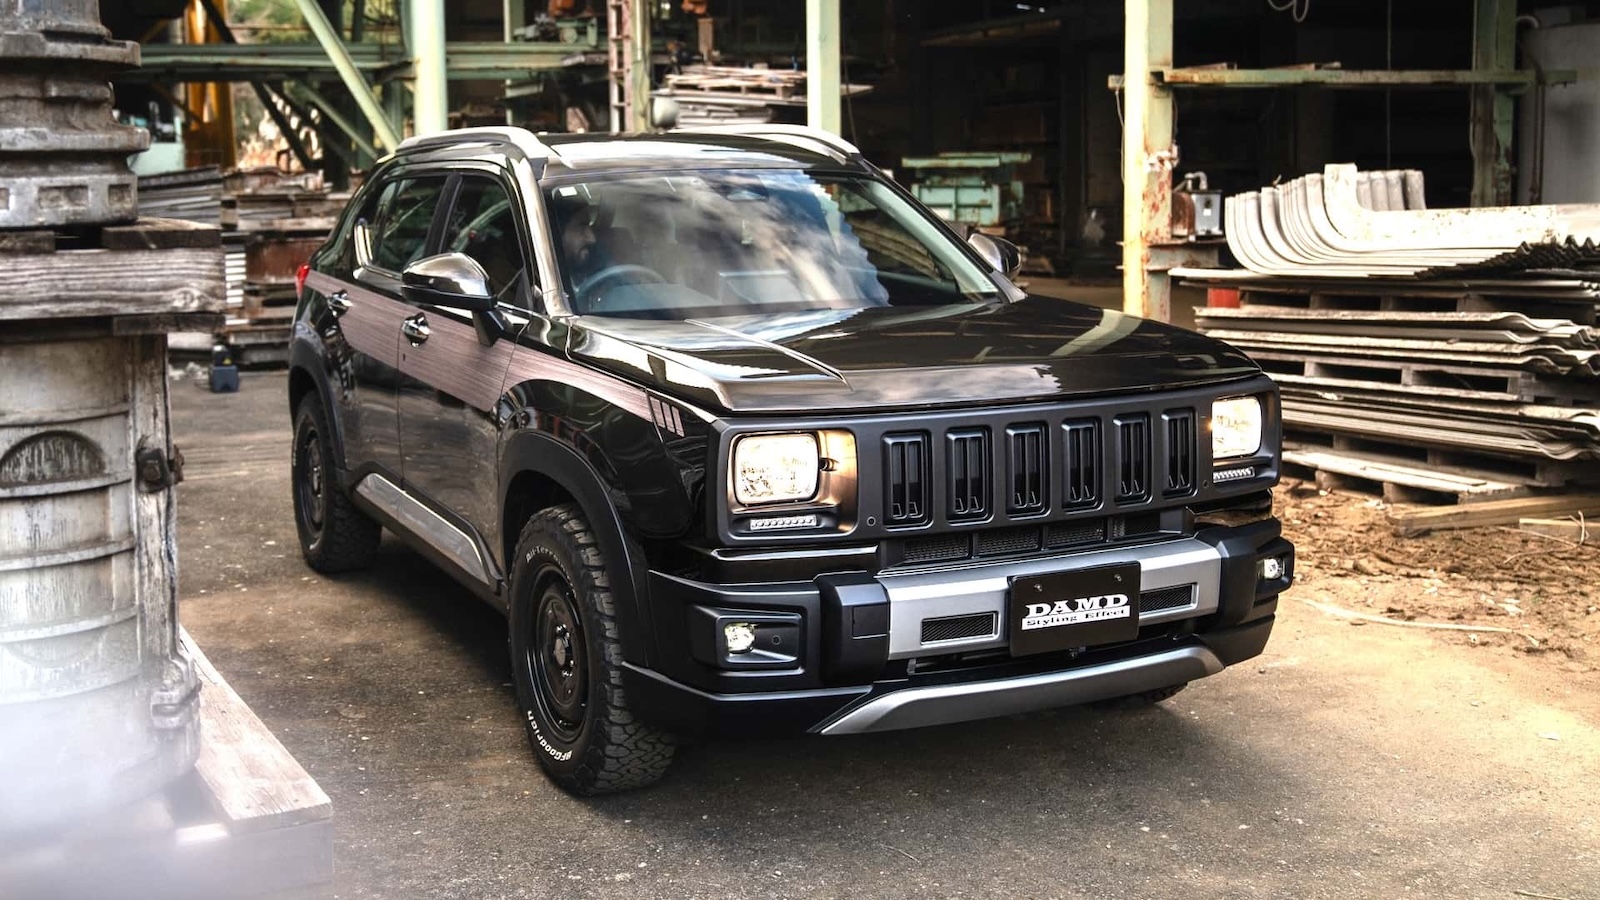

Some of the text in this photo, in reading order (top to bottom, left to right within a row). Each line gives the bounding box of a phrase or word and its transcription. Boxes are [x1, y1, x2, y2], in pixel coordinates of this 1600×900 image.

[1025, 594, 1129, 618] DAMD
[1027, 609, 1126, 626] Styling Effect
[527, 710, 573, 761] BFGoodrich
